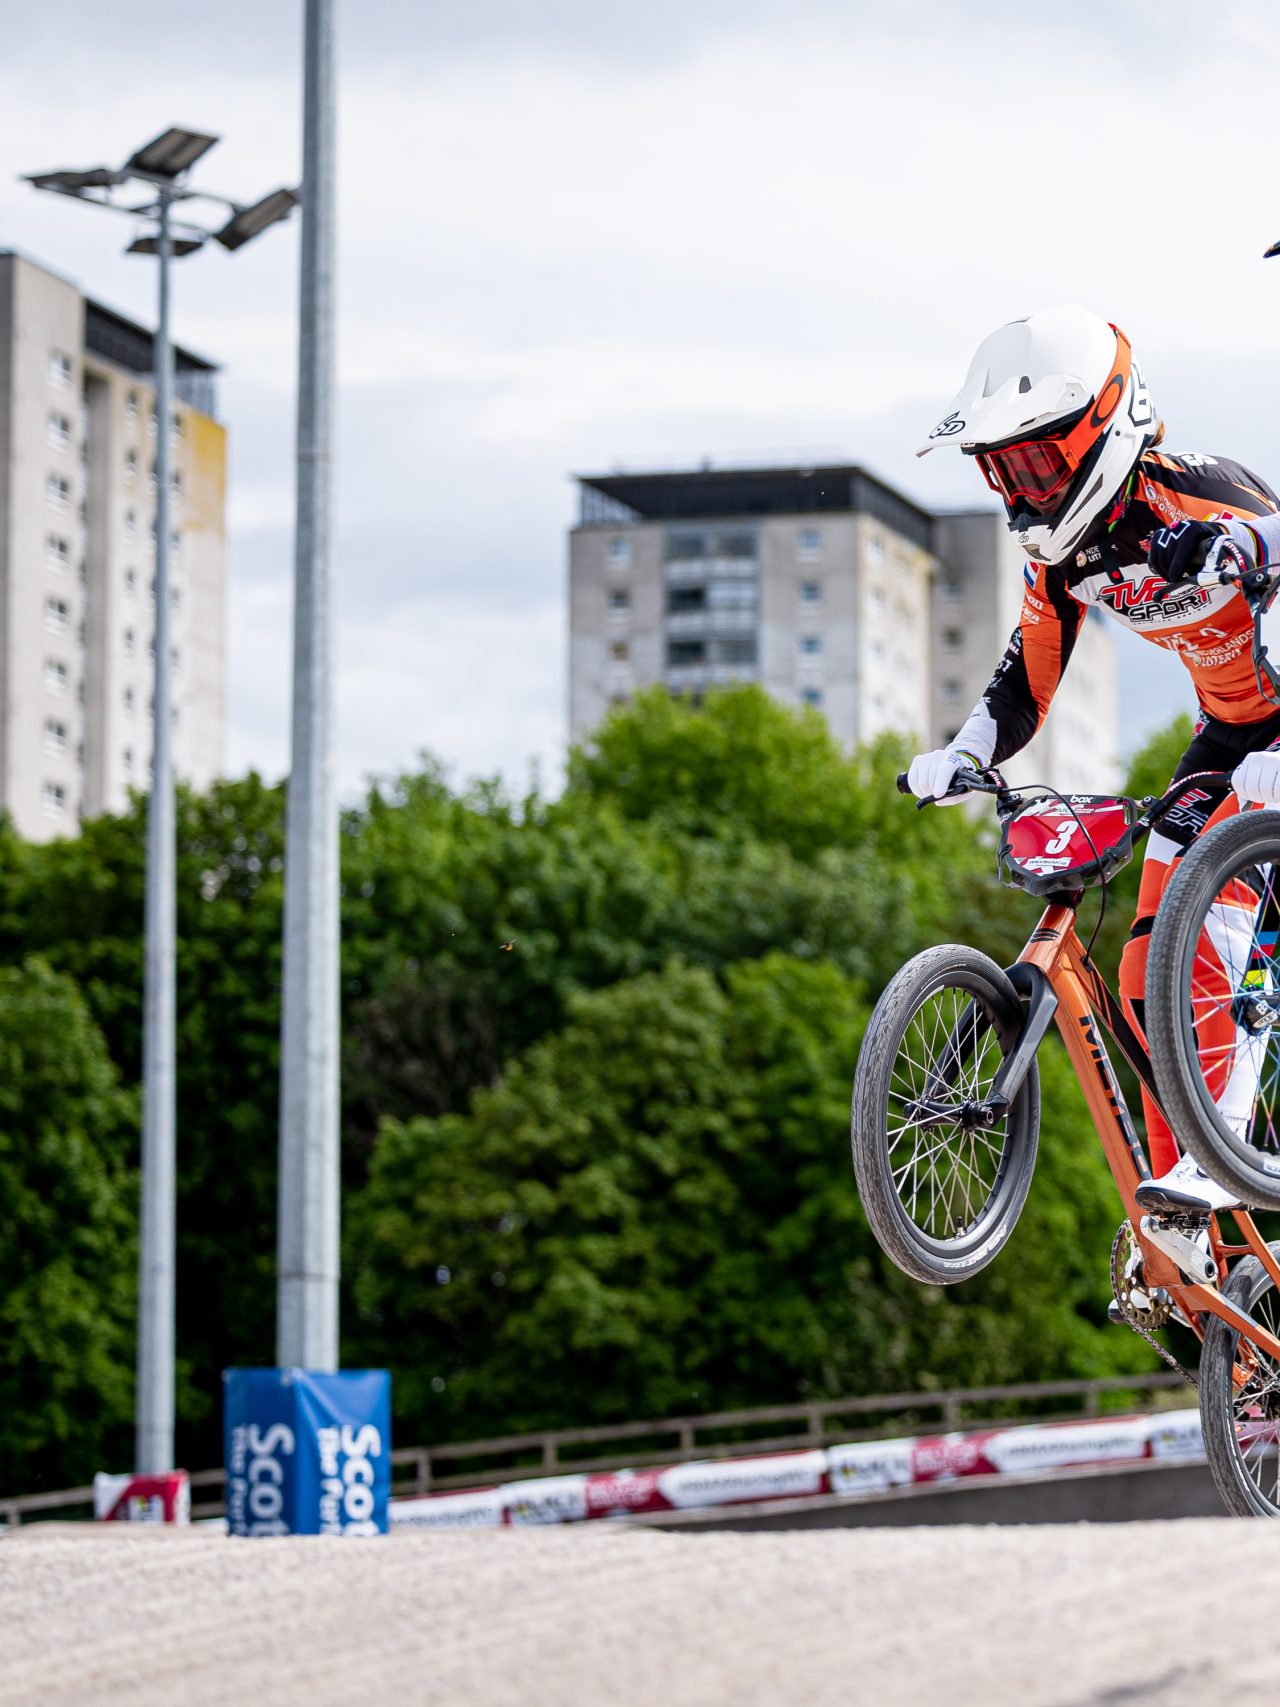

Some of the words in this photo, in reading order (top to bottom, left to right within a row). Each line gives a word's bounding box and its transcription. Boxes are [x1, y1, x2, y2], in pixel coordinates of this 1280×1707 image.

[1128, 588, 1211, 621] SPORT
[1070, 794, 1094, 804] box
[1045, 820, 1079, 855] 3
